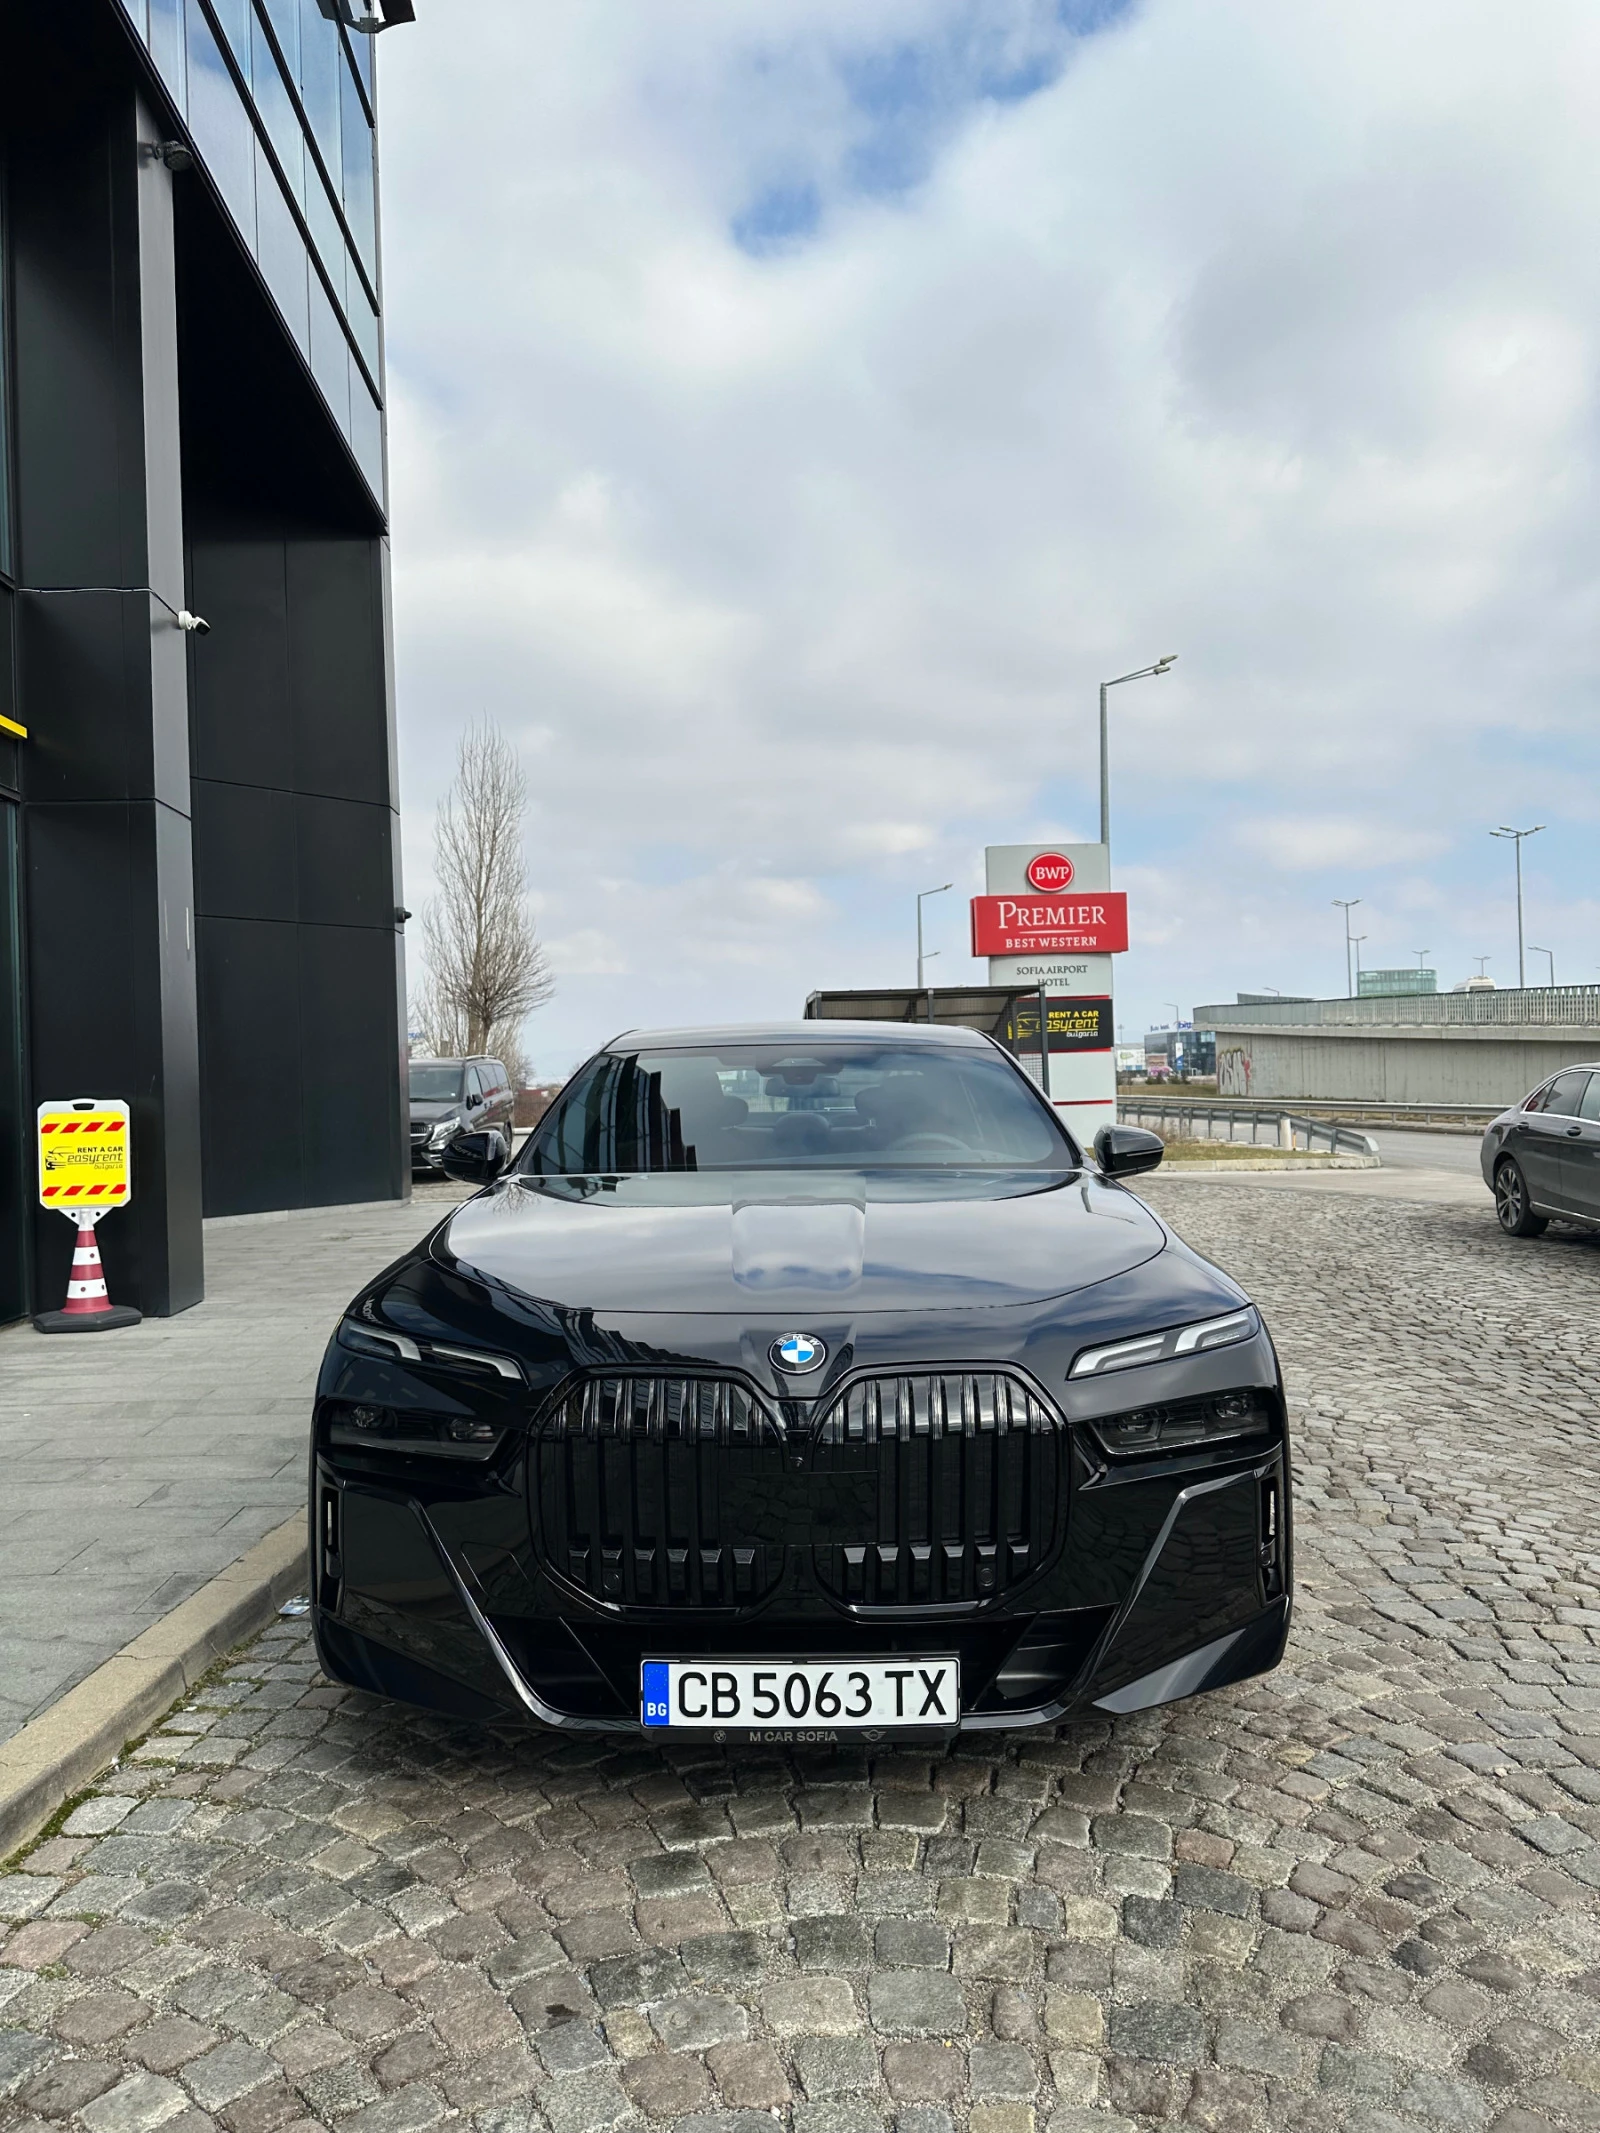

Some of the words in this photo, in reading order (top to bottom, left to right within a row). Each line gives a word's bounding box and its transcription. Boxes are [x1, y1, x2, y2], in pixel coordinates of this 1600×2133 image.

[1035, 866, 1070, 880] BWP
[1005, 938, 1036, 949] BEST
[1039, 936, 1097, 948] WESTERN
[1016, 966, 1045, 975] SOFIA
[1046, 965, 1088, 975] AIRPORT
[1066, 1030, 1098, 1038] bulgaria
[67, 1153, 123, 1164] easyrent
[678, 1671, 741, 1719] CB
[752, 1671, 872, 1719] 5063
[884, 1669, 947, 1717] TX
[647, 1702, 667, 1716] BG
[749, 1731, 761, 1742] M
[764, 1731, 793, 1742] CAR
[796, 1731, 838, 1742] SOFIA
